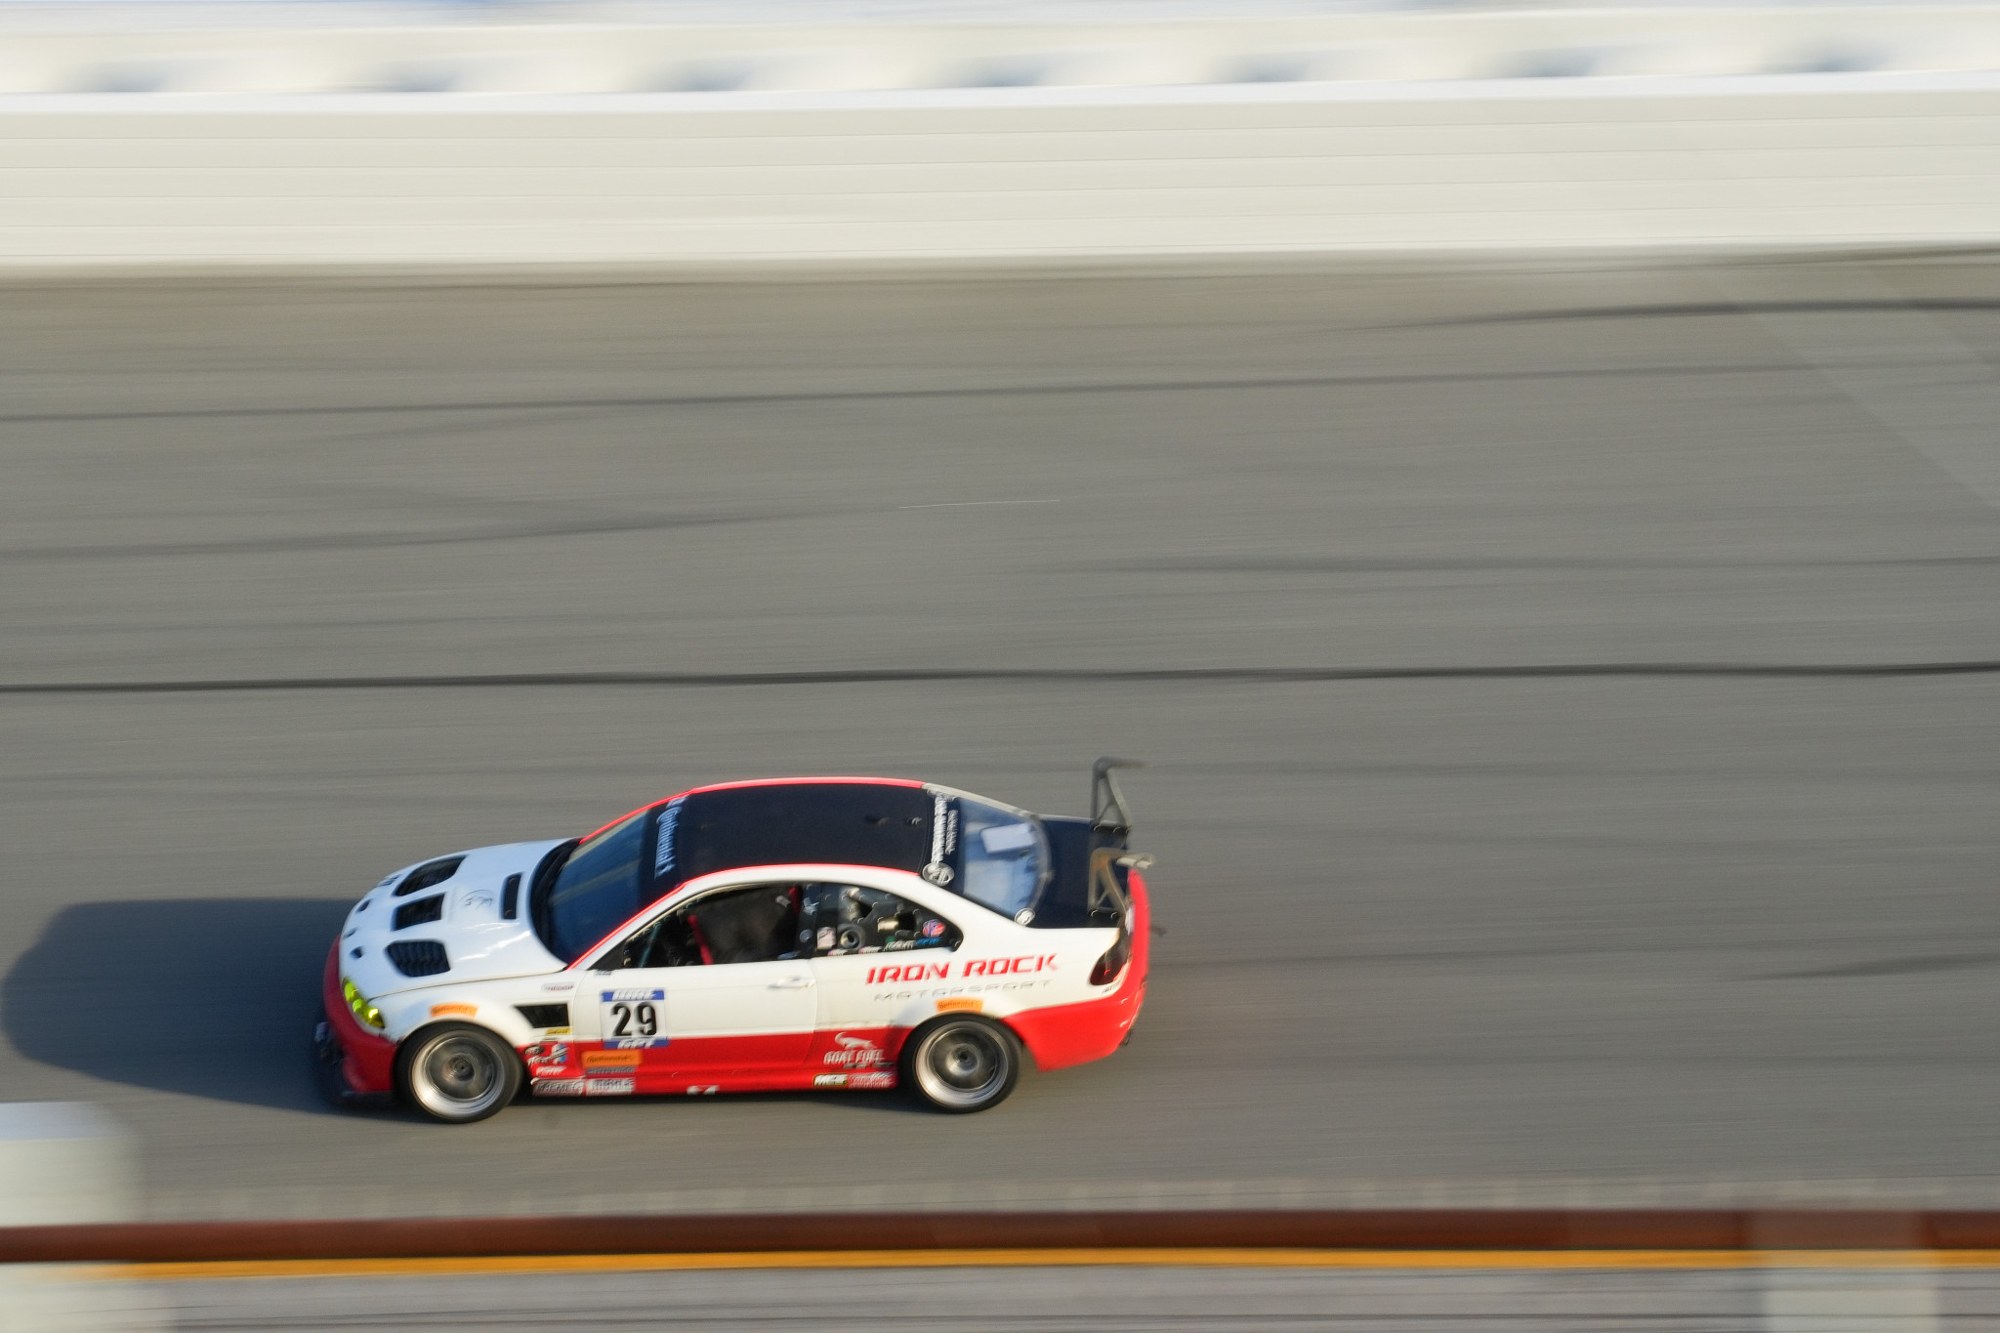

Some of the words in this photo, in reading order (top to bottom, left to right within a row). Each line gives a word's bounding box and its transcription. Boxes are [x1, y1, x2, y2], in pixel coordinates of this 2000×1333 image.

[866, 962, 950, 985] IRON
[962, 954, 1058, 978] ROCK
[874, 980, 1054, 1001] MOTORSPORT
[610, 1001, 658, 1036] 29
